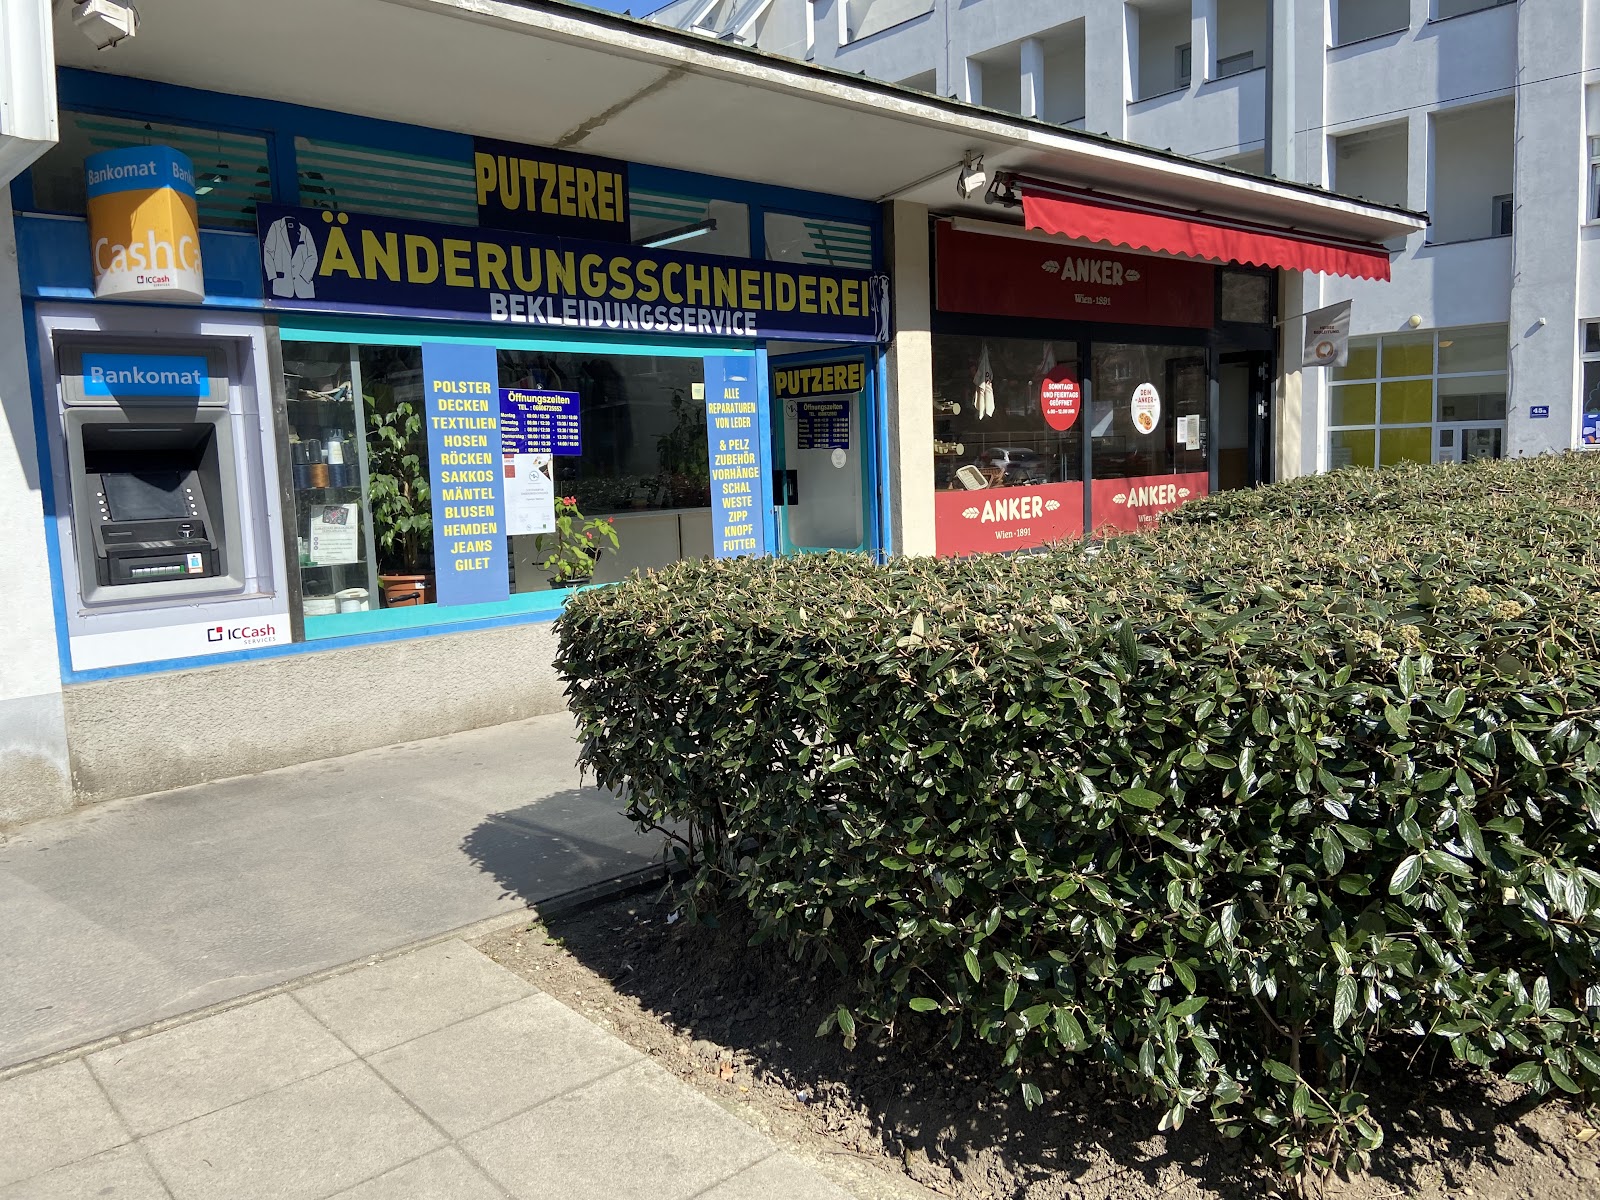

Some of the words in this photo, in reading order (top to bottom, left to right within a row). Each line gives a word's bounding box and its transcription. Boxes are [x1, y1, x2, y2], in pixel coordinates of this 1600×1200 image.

[88, 161, 157, 186] Bankomat
[474, 151, 624, 223] PUTZEREI
[95, 229, 175, 275] Cash
[319, 210, 869, 317] ÄNDERUNGSSCHNEIDEREI
[1060, 256, 1124, 286] ANKER
[146, 275, 170, 283] ICCash
[1074, 293, 1092, 304] Wien
[490, 293, 757, 336] BEKLEIDUNGSSERVICE
[90, 366, 201, 385] Bankomat
[774, 363, 865, 396] PUTZEREI
[433, 380, 492, 394] POLSTER
[724, 387, 740, 399] ALLE
[508, 391, 570, 405] Öffnungszeiten
[1049, 398, 1073, 406] GEÖFFNET
[438, 399, 489, 412] DECKEN
[708, 402, 756, 414] REPARATUREN
[431, 417, 497, 430] TEXTILIEN
[715, 417, 730, 429] VON
[731, 416, 751, 429] LEDER
[443, 435, 488, 447] HOSEN
[719, 439, 726, 451] &
[728, 438, 750, 451] PELZ
[441, 450, 492, 465] RÖCKEN
[715, 451, 755, 466] ZUBEHÖR
[441, 470, 494, 483] SAKKOS
[712, 466, 760, 480] VORHÄNGE
[442, 486, 495, 501] MÄNTEL
[722, 482, 751, 494] SCHAL
[722, 496, 752, 508] WESTE
[1126, 483, 1177, 509] ANKER
[444, 505, 495, 519] BLUSEN
[728, 510, 748, 523] ZIPP
[981, 495, 1043, 524] ANKER
[443, 522, 497, 537] HEMDEN
[724, 524, 753, 537] KNOPF
[995, 530, 1013, 540] Wien
[1016, 527, 1031, 538] 1891
[450, 539, 493, 554] JEANS
[723, 538, 756, 552] FUTTER
[455, 557, 490, 571] GILET
[228, 624, 276, 640] ICCash
[244, 637, 276, 645] SERVICES
